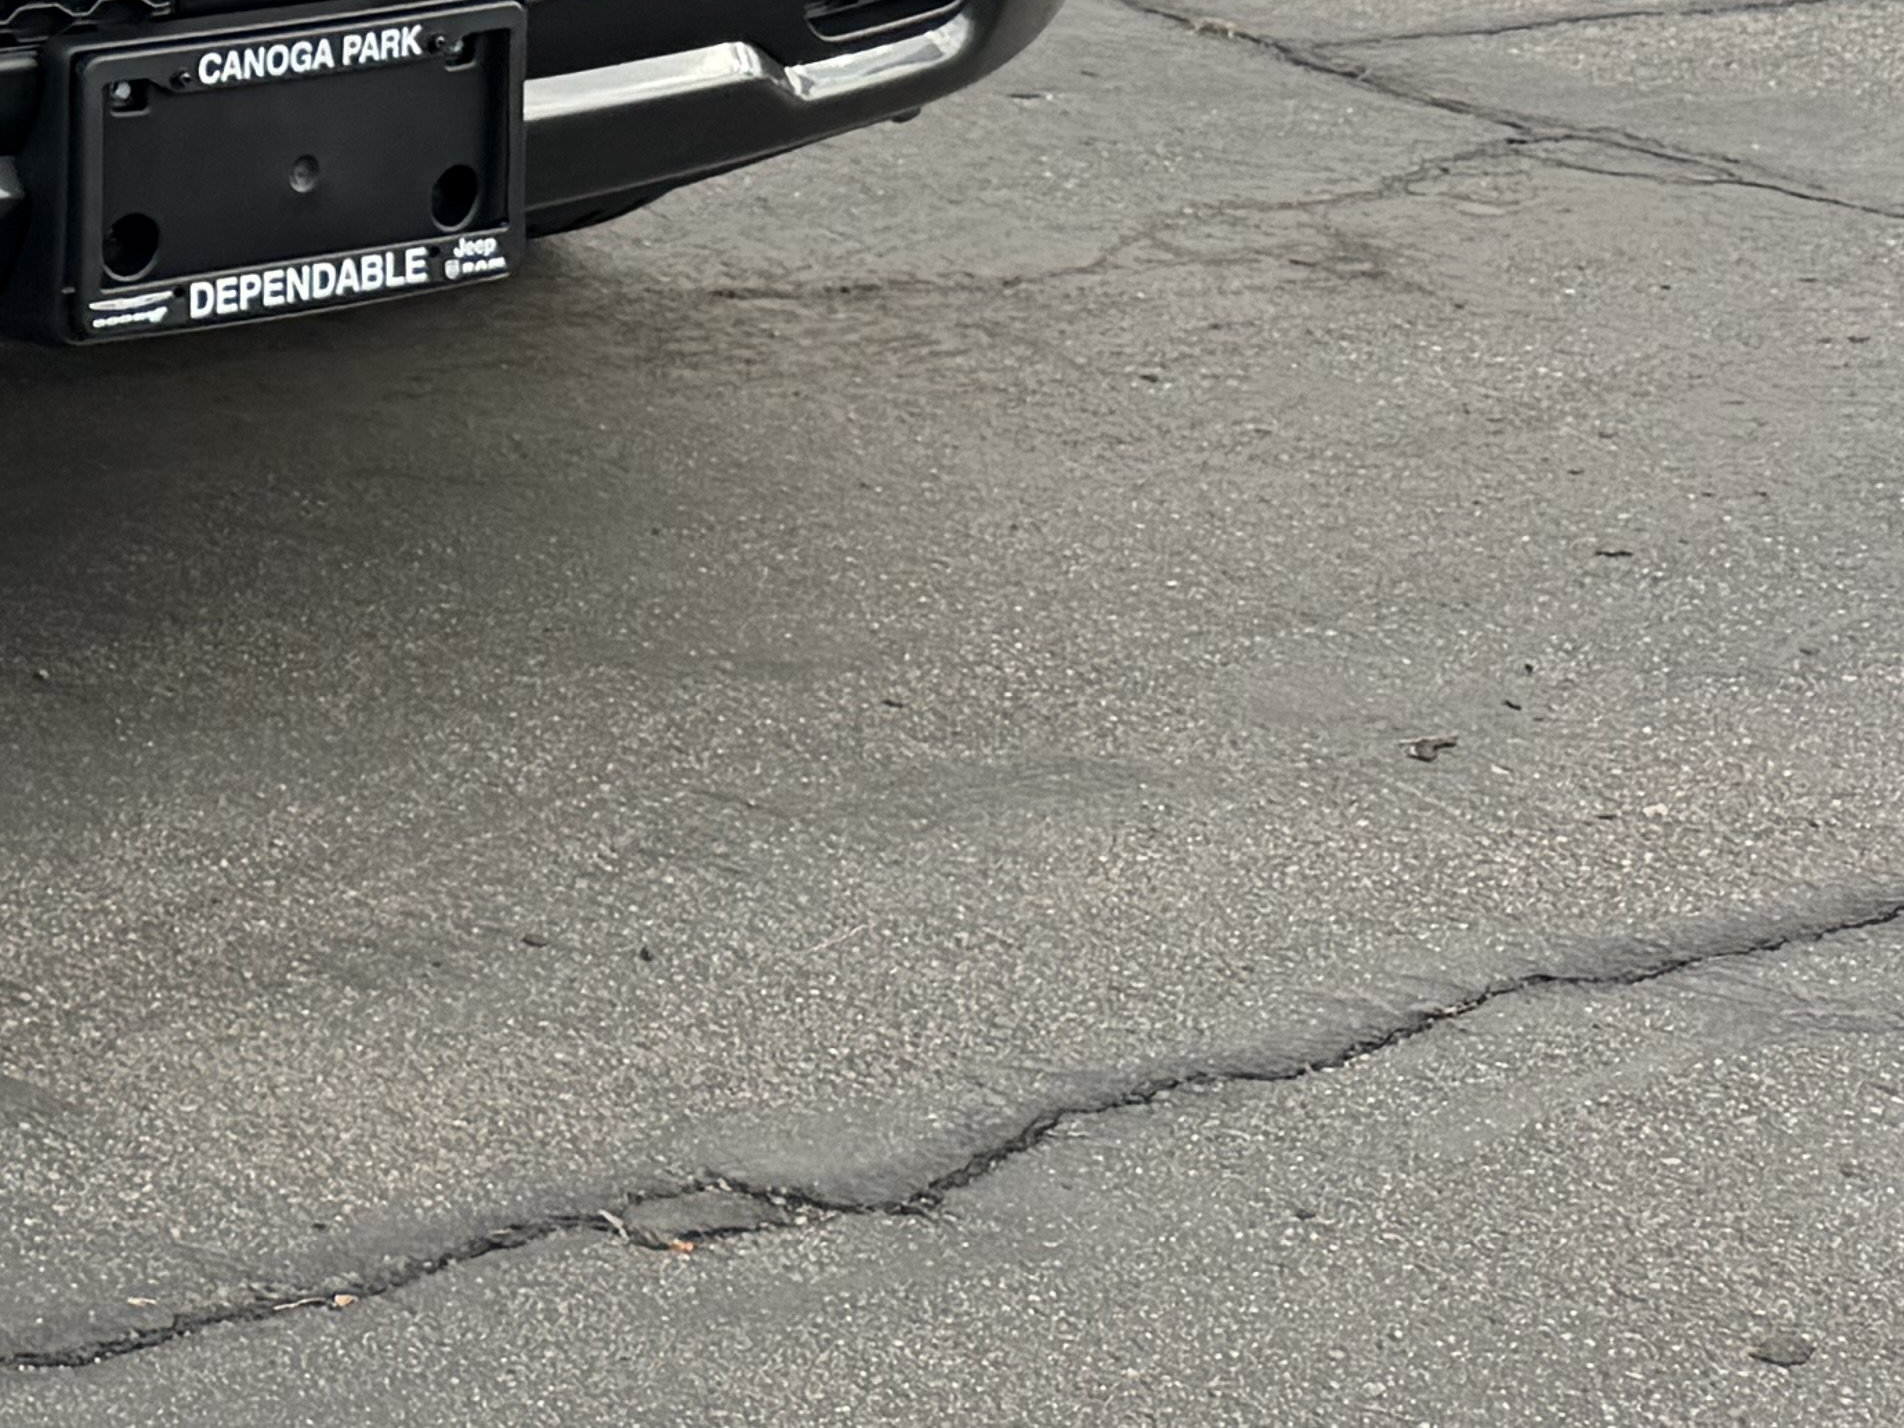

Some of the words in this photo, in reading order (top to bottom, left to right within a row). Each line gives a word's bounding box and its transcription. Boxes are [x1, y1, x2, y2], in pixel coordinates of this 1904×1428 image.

[198, 39, 334, 85] CANOGA
[342, 24, 423, 68] PARK
[189, 246, 428, 320] DEPENDABLE
